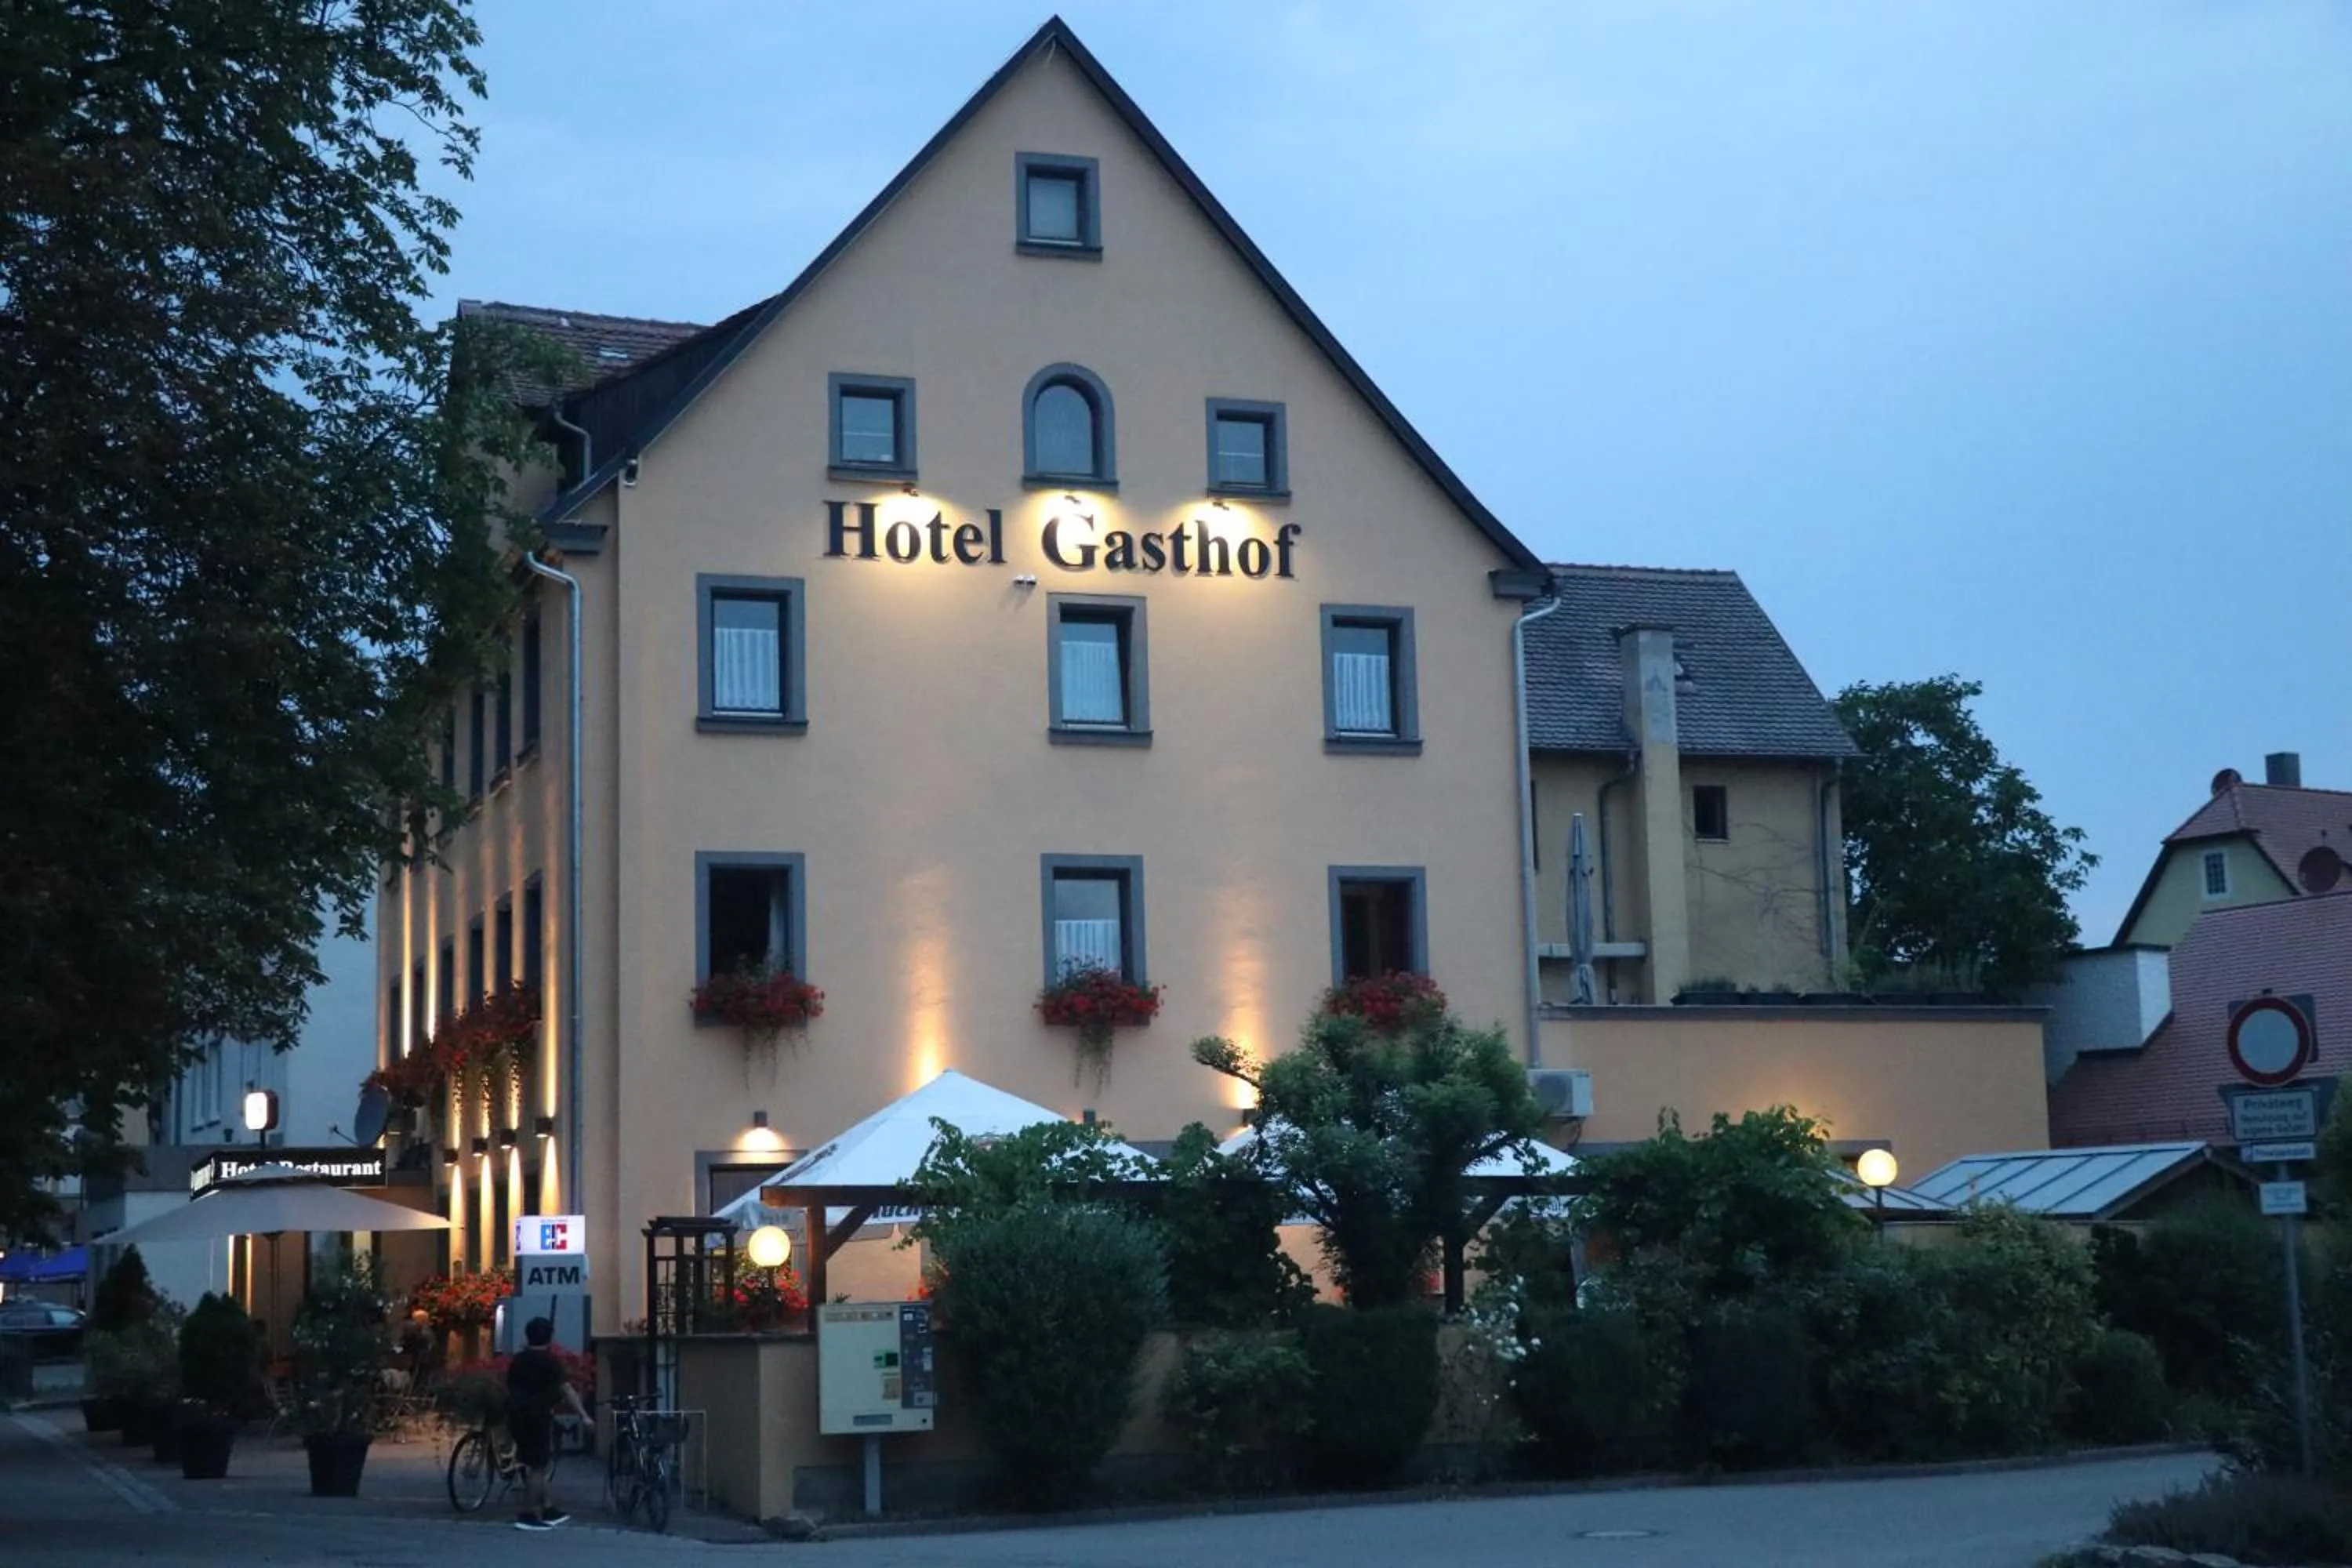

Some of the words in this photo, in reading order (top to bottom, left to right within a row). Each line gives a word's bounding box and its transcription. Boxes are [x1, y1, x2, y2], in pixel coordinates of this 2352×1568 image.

[823, 500, 1007, 564] Hotel
[1042, 514, 1301, 579] Gasthof
[220, 1161, 272, 1178] Hot
[528, 1266, 579, 1285] ATM
